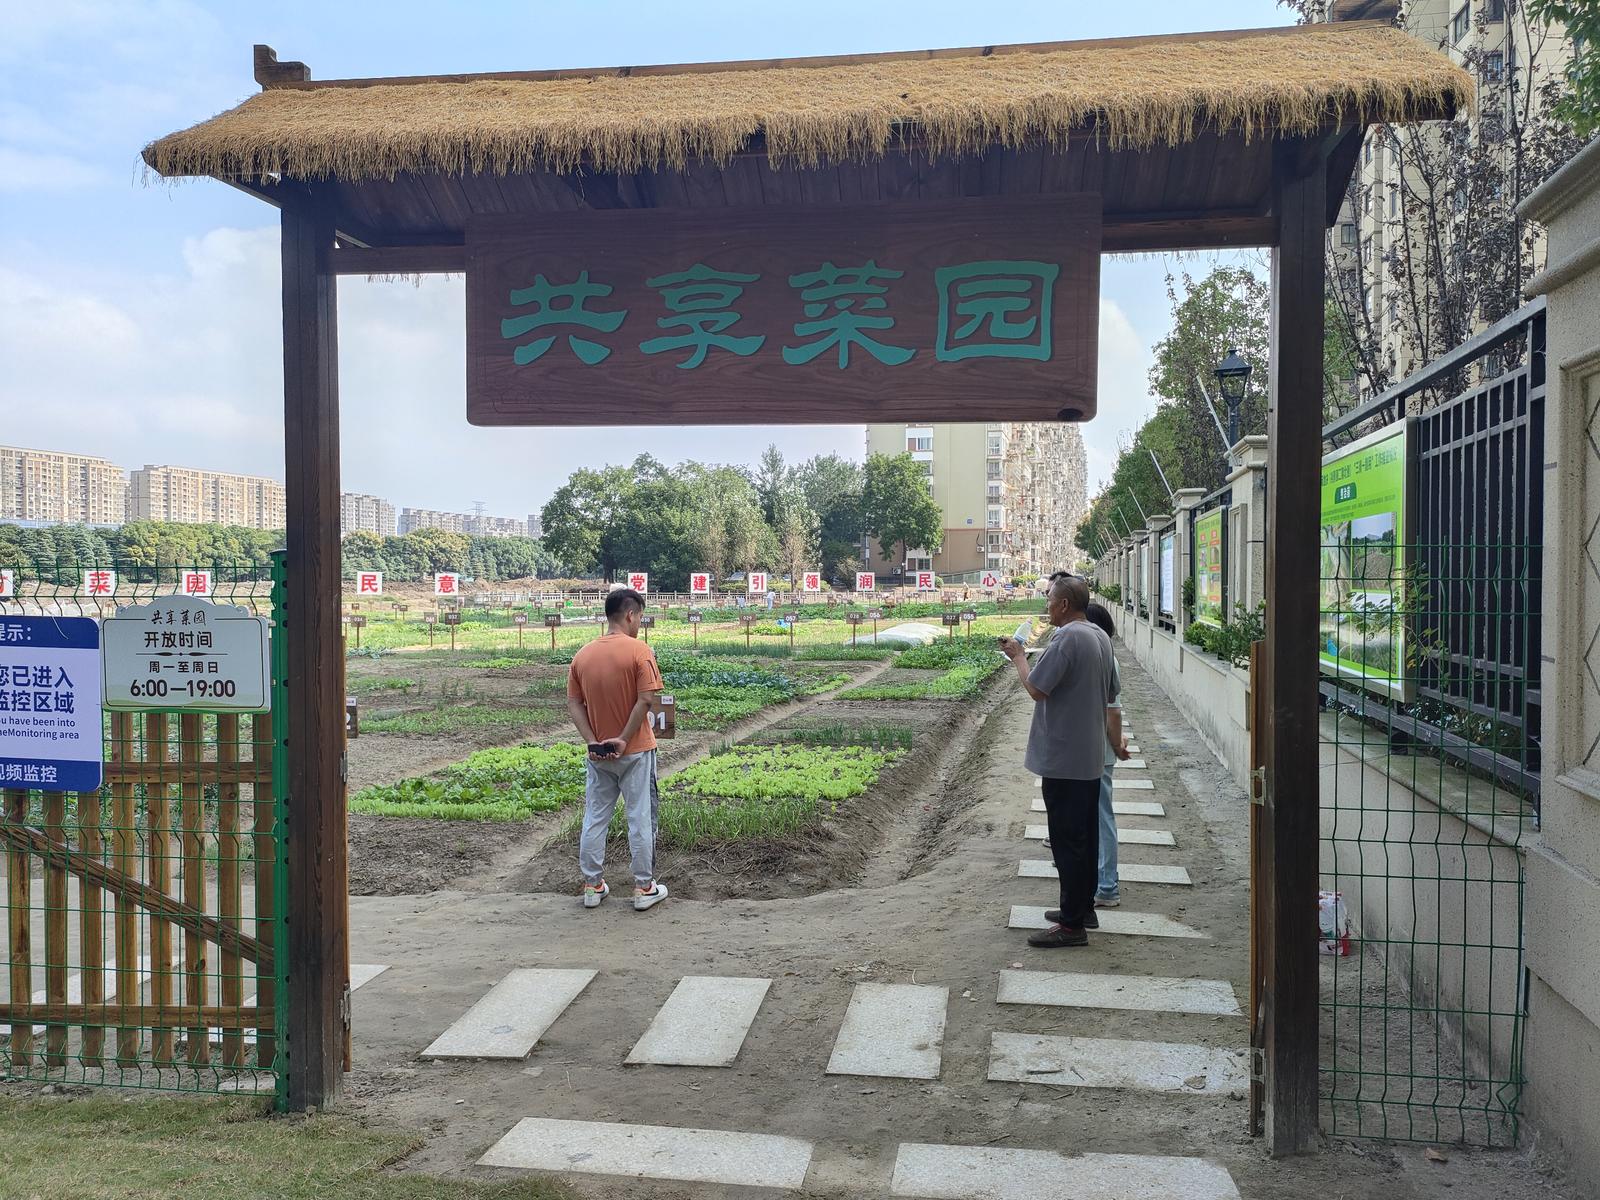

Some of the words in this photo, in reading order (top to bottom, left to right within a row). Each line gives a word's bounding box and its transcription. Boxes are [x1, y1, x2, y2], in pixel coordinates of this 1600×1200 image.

[501, 259, 1060, 370] 共享菜园
[151, 610, 206, 625] 共享菜园
[144, 631, 213, 648] 开放时间
[149, 661, 219, 673] 周一至周日
[9, 716, 31, 725] have
[33, 717, 55, 727] been
[57, 718, 76, 727] into
